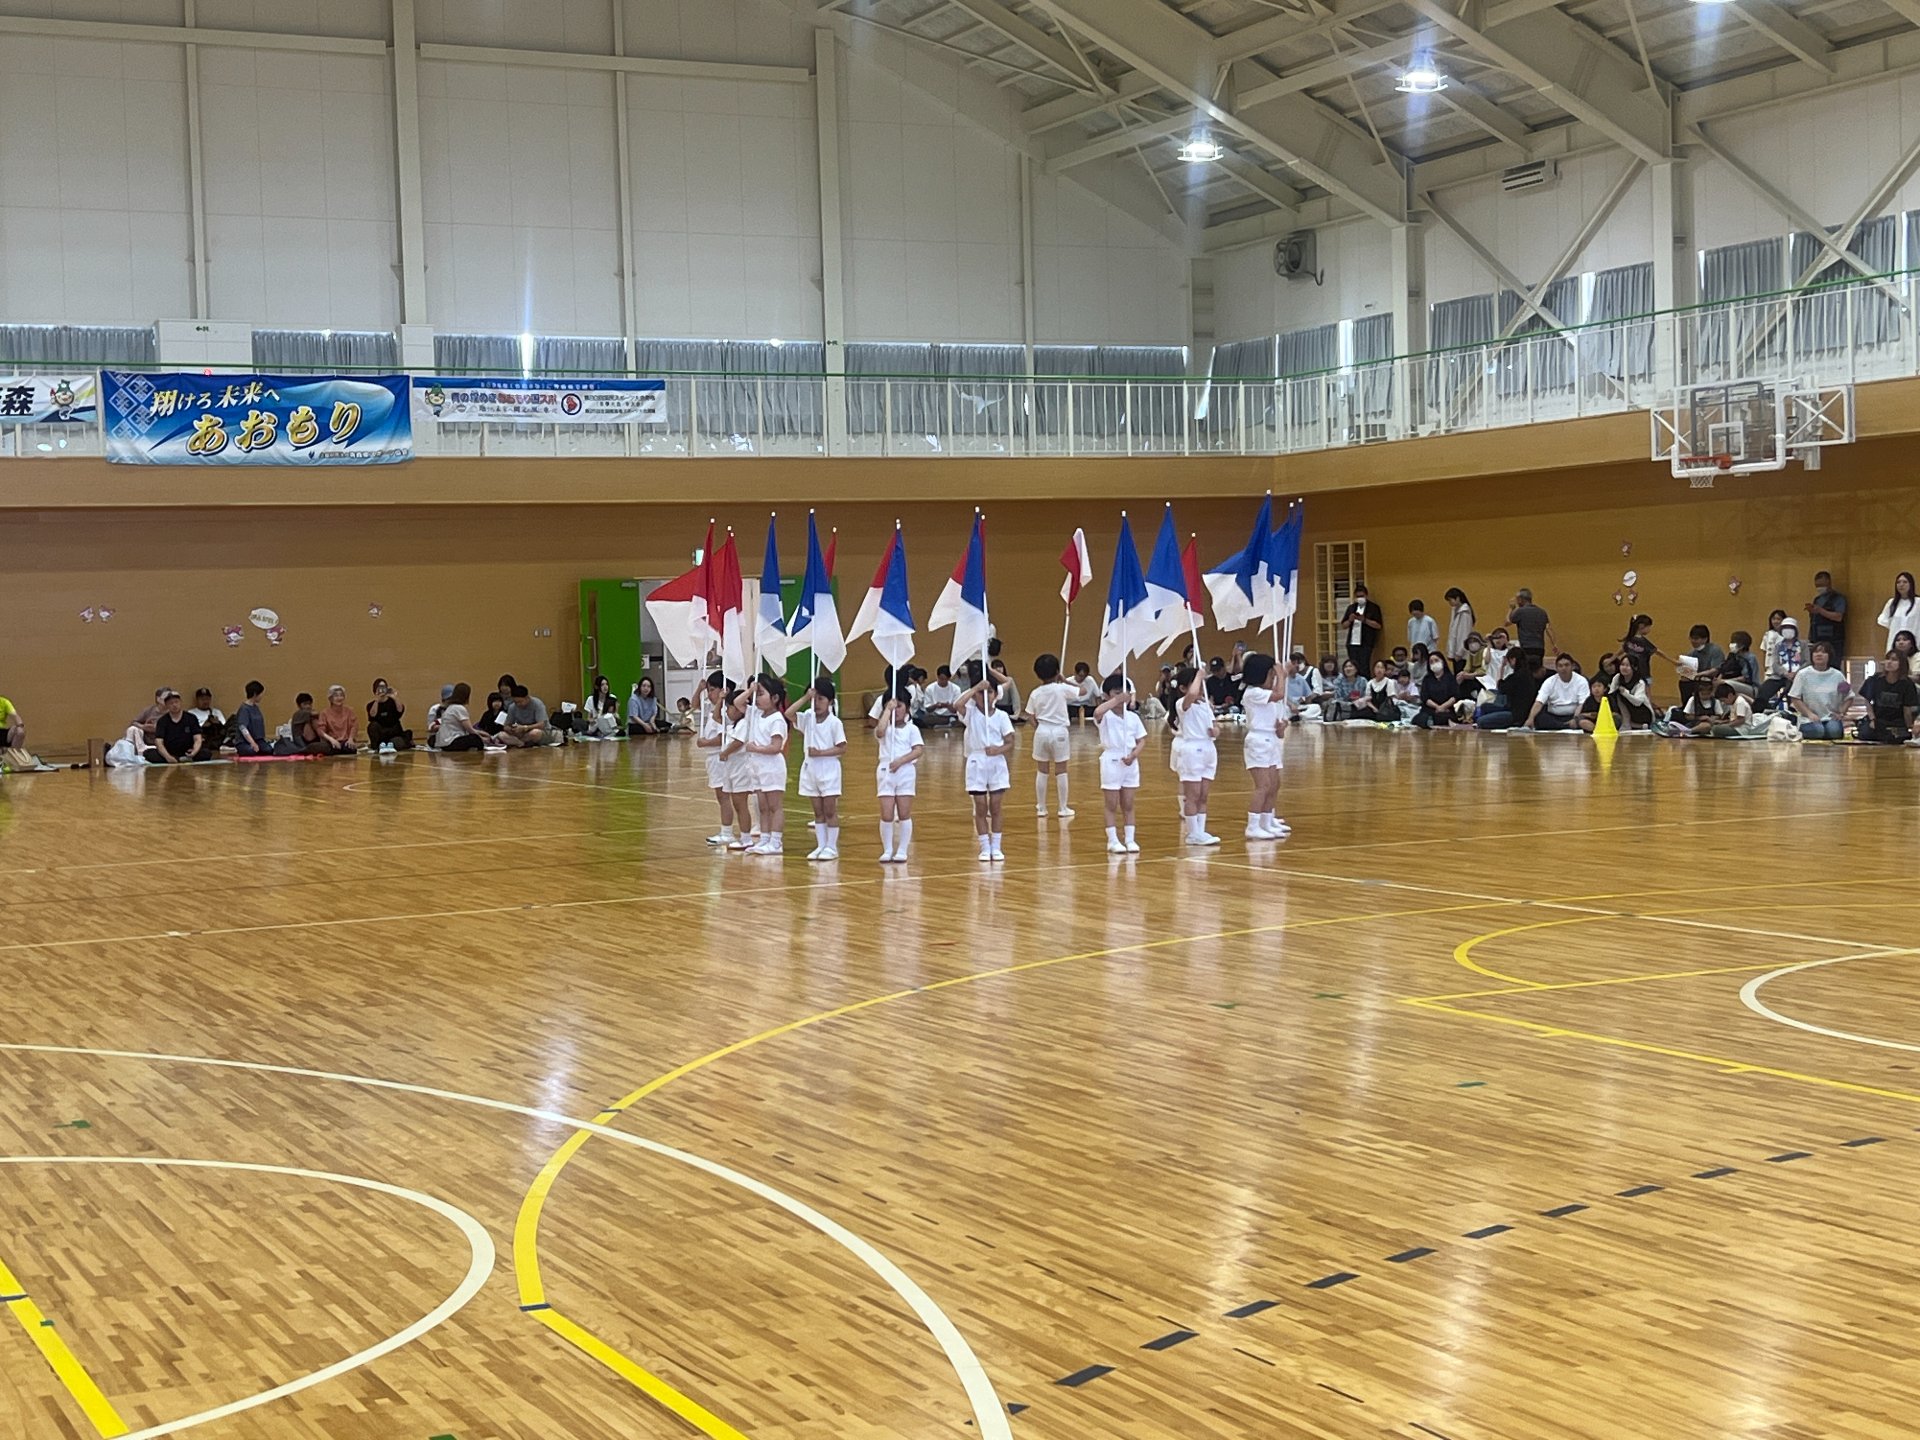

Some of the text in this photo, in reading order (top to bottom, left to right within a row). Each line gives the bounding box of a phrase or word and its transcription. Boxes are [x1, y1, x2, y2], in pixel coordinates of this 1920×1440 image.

[0, 385, 35, 415] 森
[187, 401, 362, 456] あおもり
